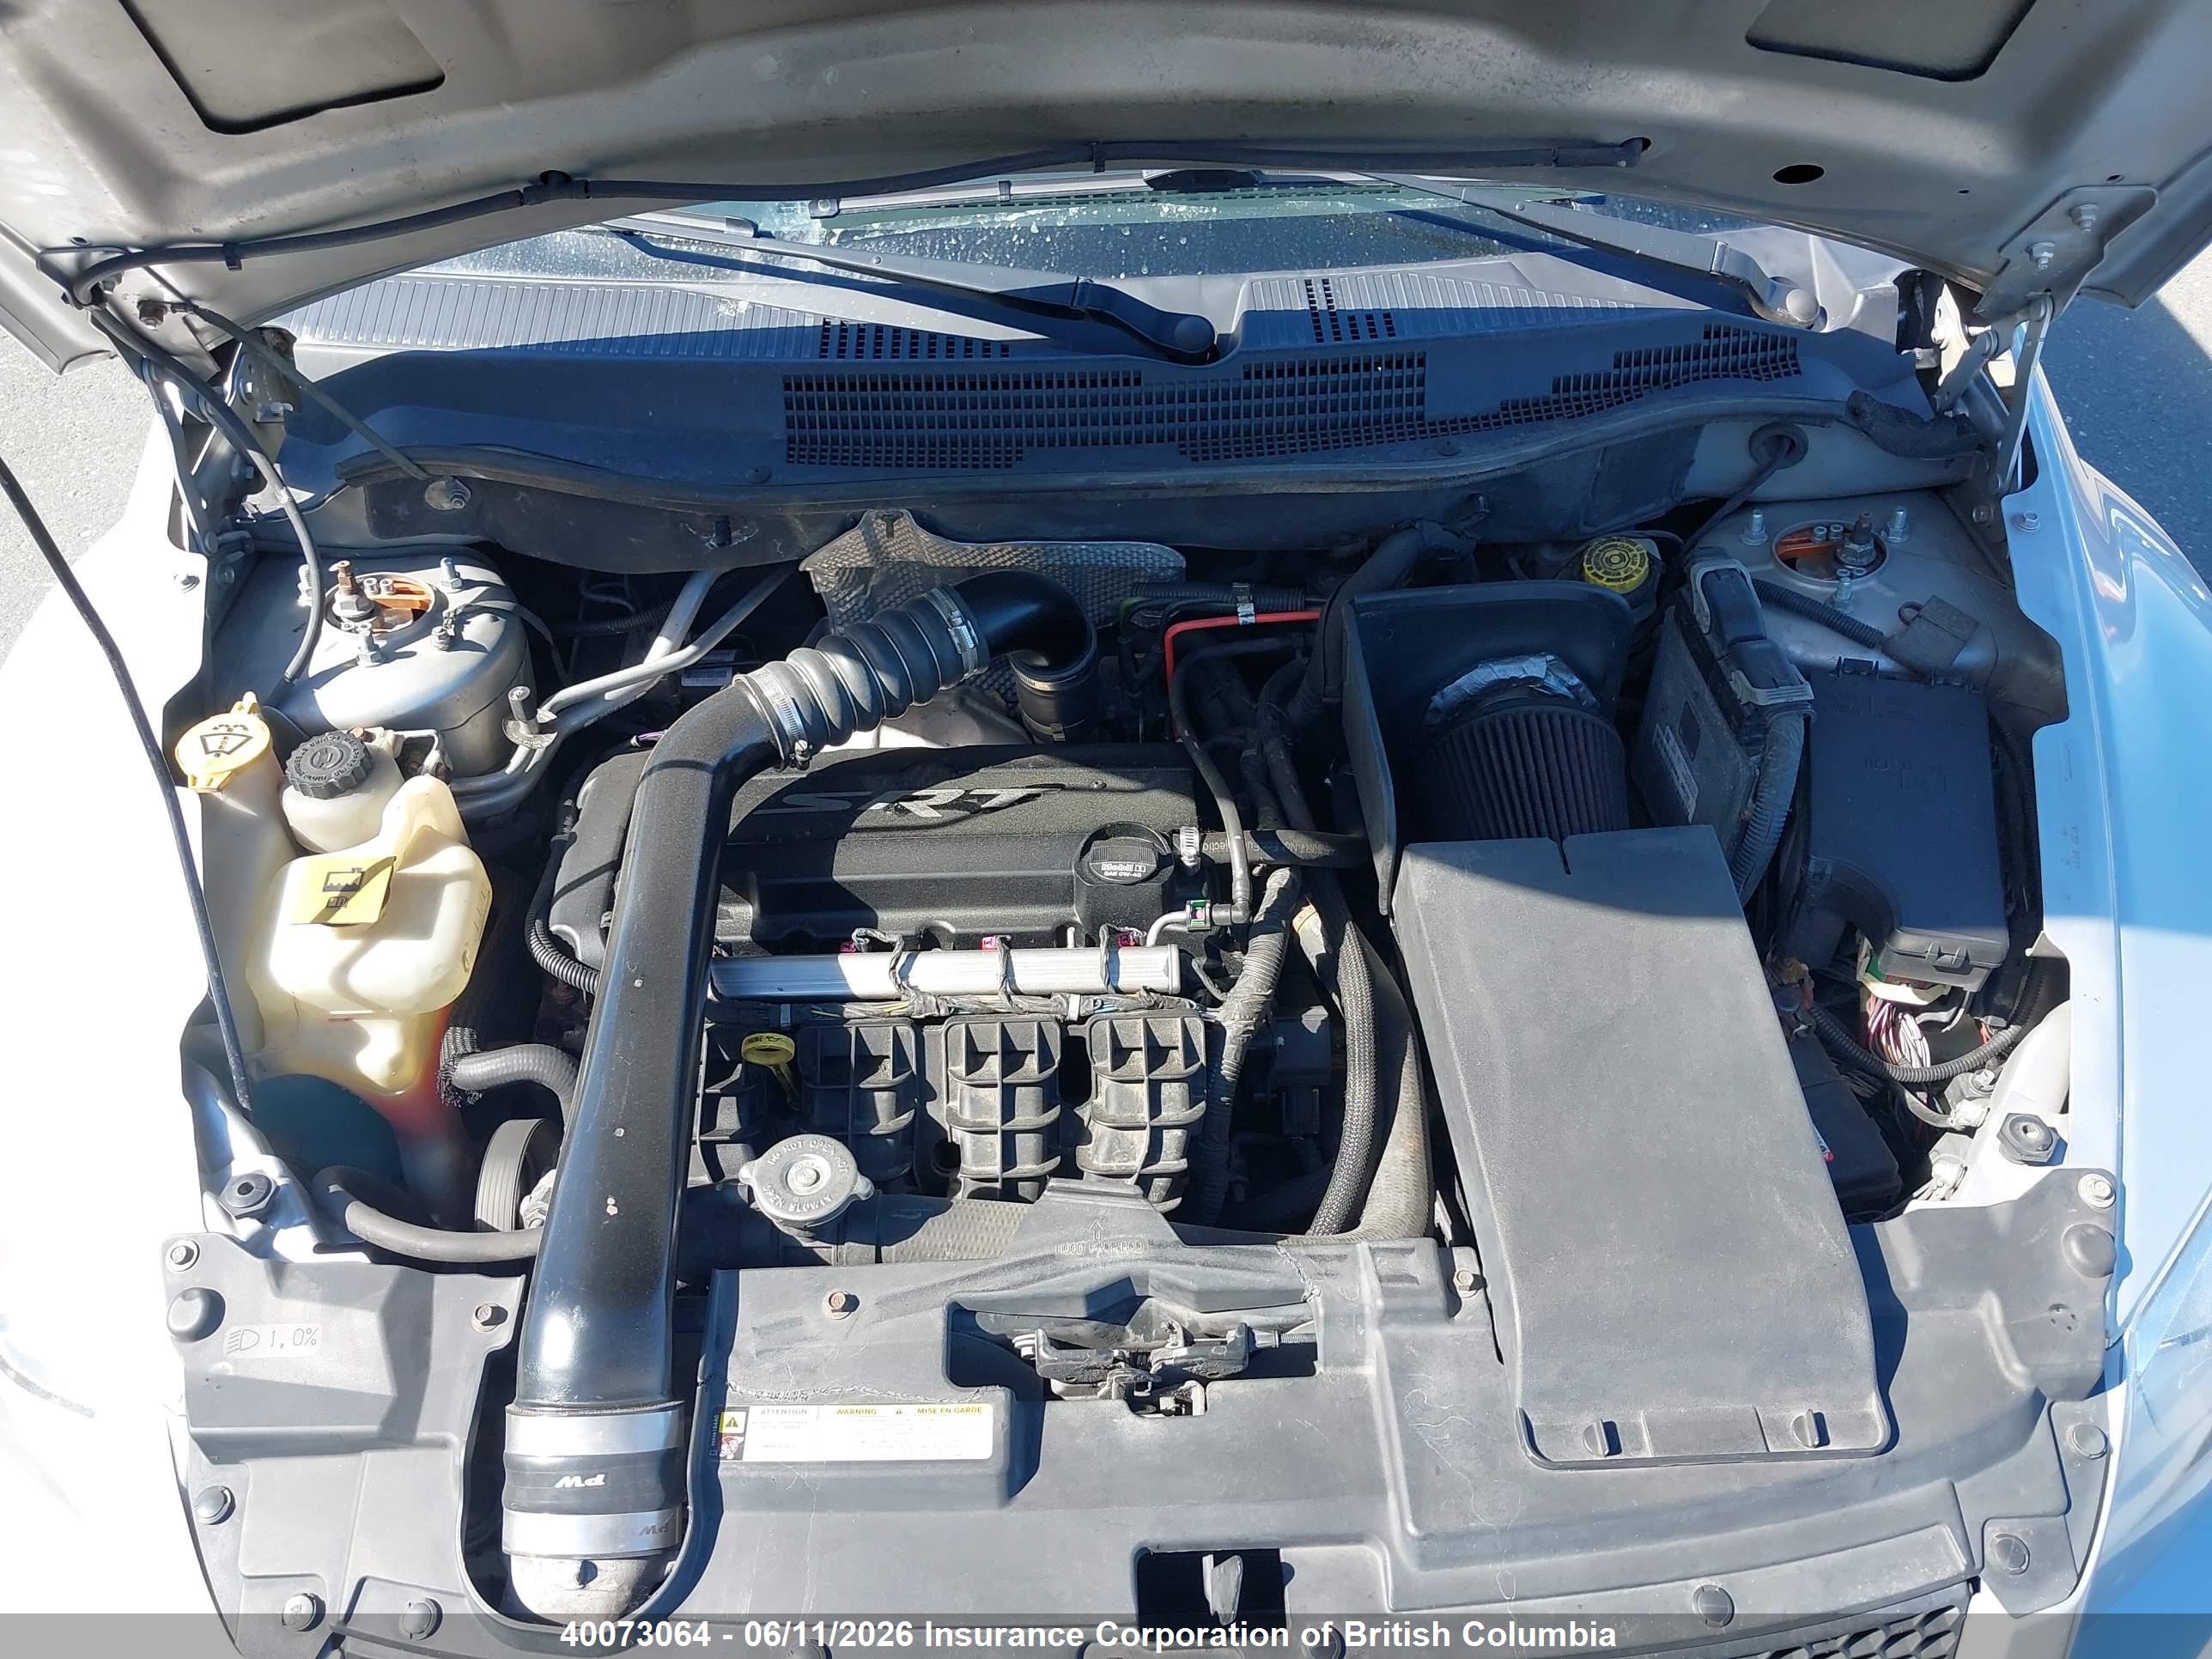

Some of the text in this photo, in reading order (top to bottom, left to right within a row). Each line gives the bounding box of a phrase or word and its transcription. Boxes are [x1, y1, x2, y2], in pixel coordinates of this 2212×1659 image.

[752, 787, 1062, 817] SRT
[1101, 863, 1133, 872] Mobil
[767, 1152, 782, 1166] DO
[782, 1140, 805, 1153] NOT
[809, 1139, 837, 1157] OPEN
[1055, 1241, 1145, 1255] HOOD PROP ROD
